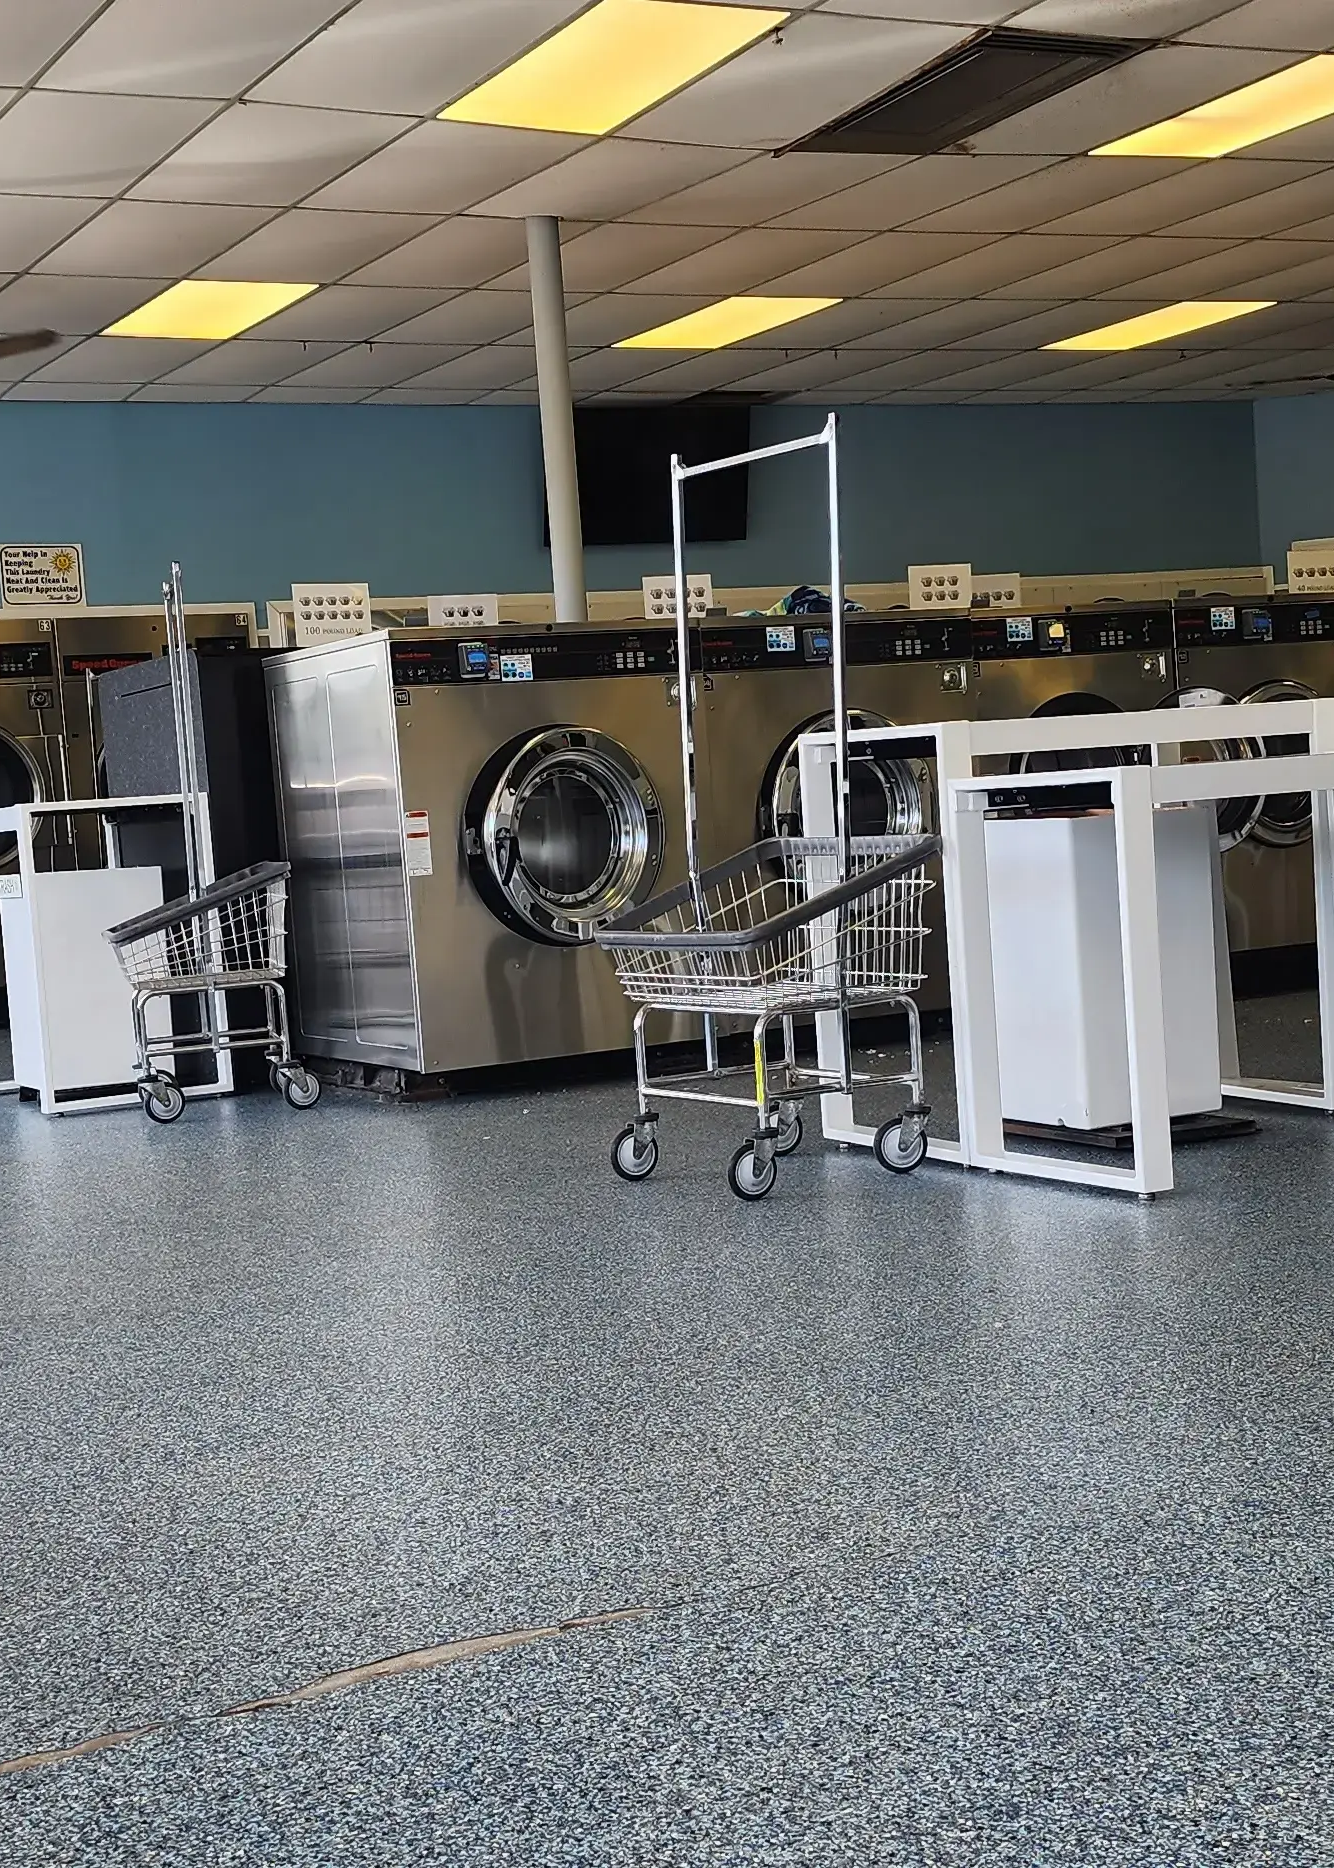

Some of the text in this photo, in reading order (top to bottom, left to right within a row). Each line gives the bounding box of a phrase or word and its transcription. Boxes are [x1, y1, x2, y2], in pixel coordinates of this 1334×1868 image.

[22, 550, 38, 559] Help
[5, 560, 33, 568] Keeping
[22, 568, 50, 576] Laundry
[7, 585, 78, 594] Greatly Appreciated
[237, 615, 247, 625] 64
[40, 620, 50, 630] 63
[305, 627, 320, 635] 100
[72, 660, 108, 671] Speed
